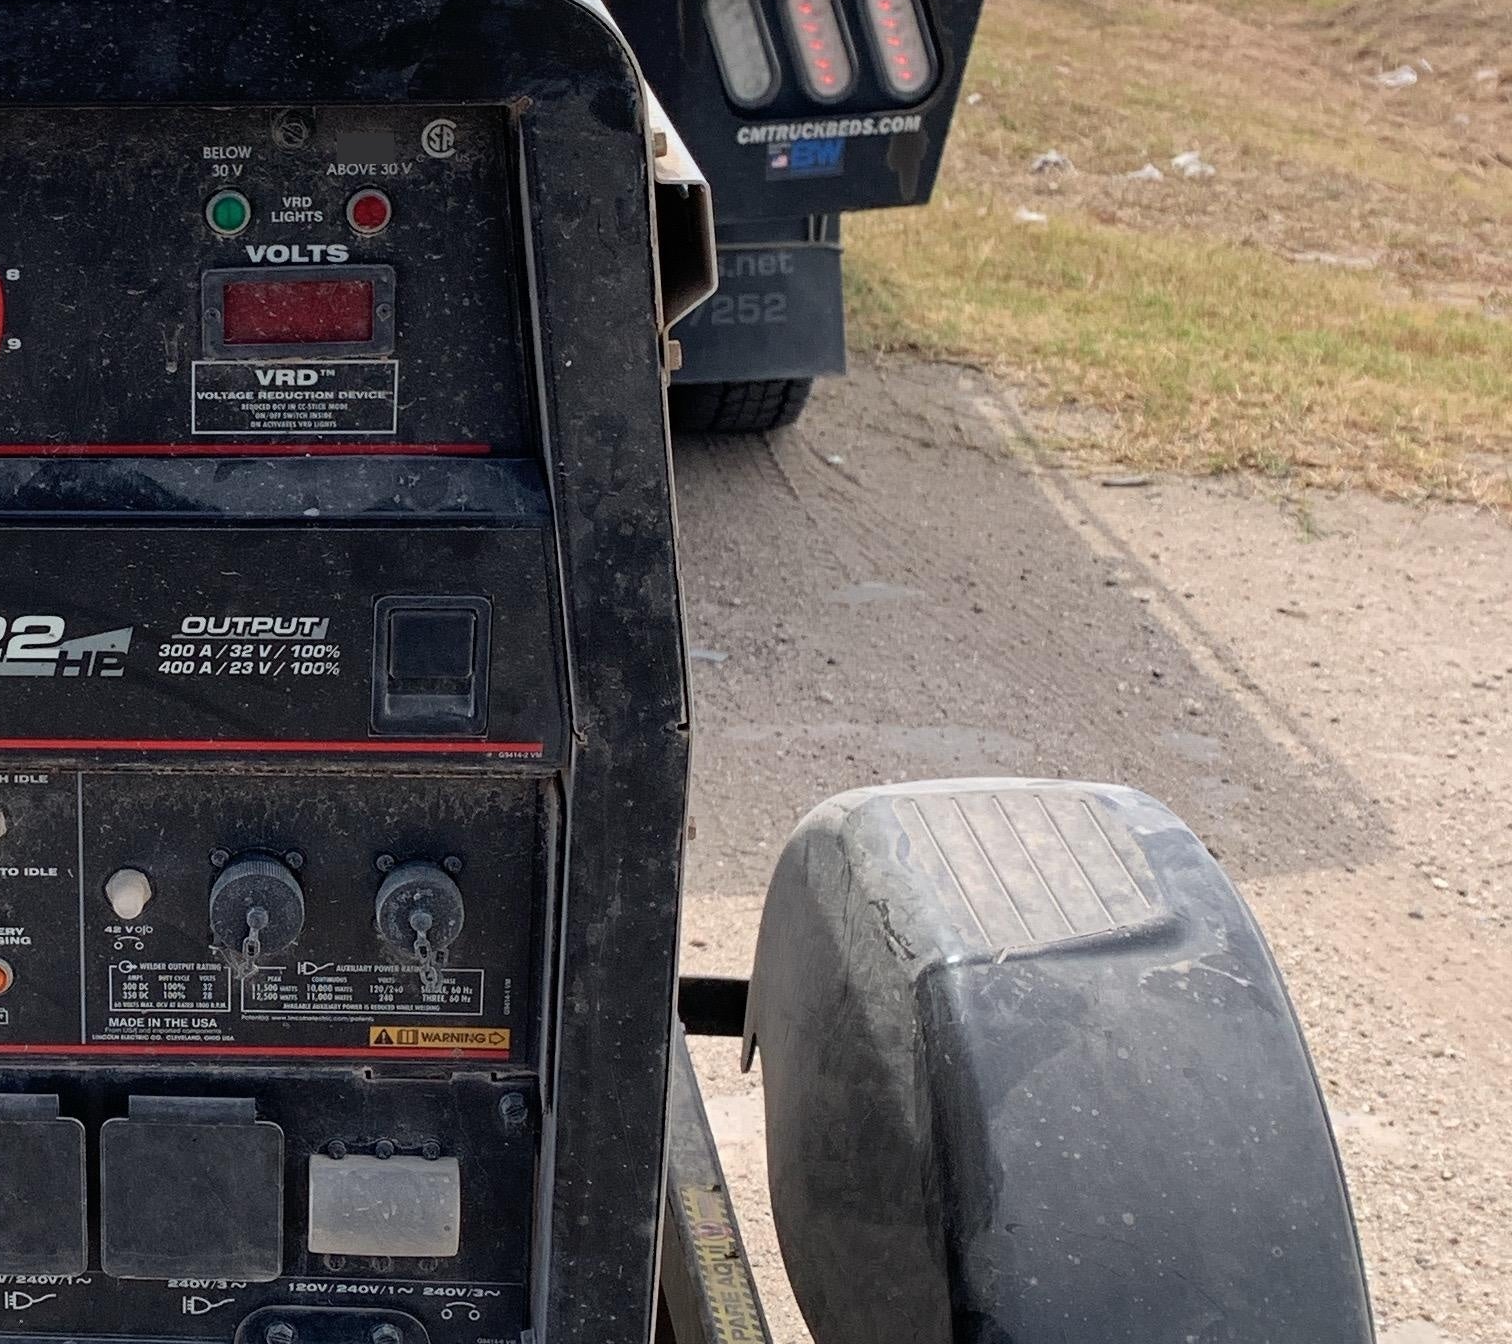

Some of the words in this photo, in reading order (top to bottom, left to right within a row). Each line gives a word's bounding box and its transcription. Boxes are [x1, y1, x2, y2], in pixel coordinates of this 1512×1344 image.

[736, 115, 922, 145] CMTRUCKBEDS.COM
[203, 146, 252, 159] BELOW
[212, 165, 228, 177] 30
[231, 164, 243, 177] V
[326, 163, 376, 175] ABOVE
[380, 163, 397, 175] 30
[400, 163, 413, 175] V
[282, 197, 312, 208] VRD
[271, 211, 323, 222] LIGHTS
[246, 244, 349, 263] VOLTS
[6, 269, 20, 281] 8
[7, 338, 22, 350] 9
[196, 391, 254, 400] VOLTAGE
[258, 391, 335, 400] REDUCTION
[181, 616, 322, 635] OUTPUT
[158, 644, 195, 658] 300
[199, 644, 212, 657] A
[229, 644, 254, 657] 32
[259, 644, 272, 657] V
[291, 645, 340, 658] 100%
[158, 661, 195, 674] 400
[198, 661, 212, 674] A
[229, 661, 253, 675] 23
[259, 661, 271, 675] V
[291, 662, 340, 676] 100%
[14, 775, 49, 784] IDLE
[24, 867, 58, 877] IDLE
[104, 925, 122, 933] 42
[139, 963, 167, 971] WELDER
[168, 963, 195, 971] OUTPUT
[196, 963, 222, 972] RATING
[336, 964, 372, 973] AUXILIARY
[374, 965, 399, 973] POWER
[163, 983, 186, 991] 100%
[202, 983, 213, 991] 32
[163, 991, 186, 999] 100%
[108, 1018, 145, 1027] MADE
[148, 1018, 161, 1027] IN
[164, 1018, 189, 1027] THE
[192, 1018, 218, 1028] USA
[421, 1032, 486, 1044] WARNING
[721, 1291, 750, 1341] PARE
